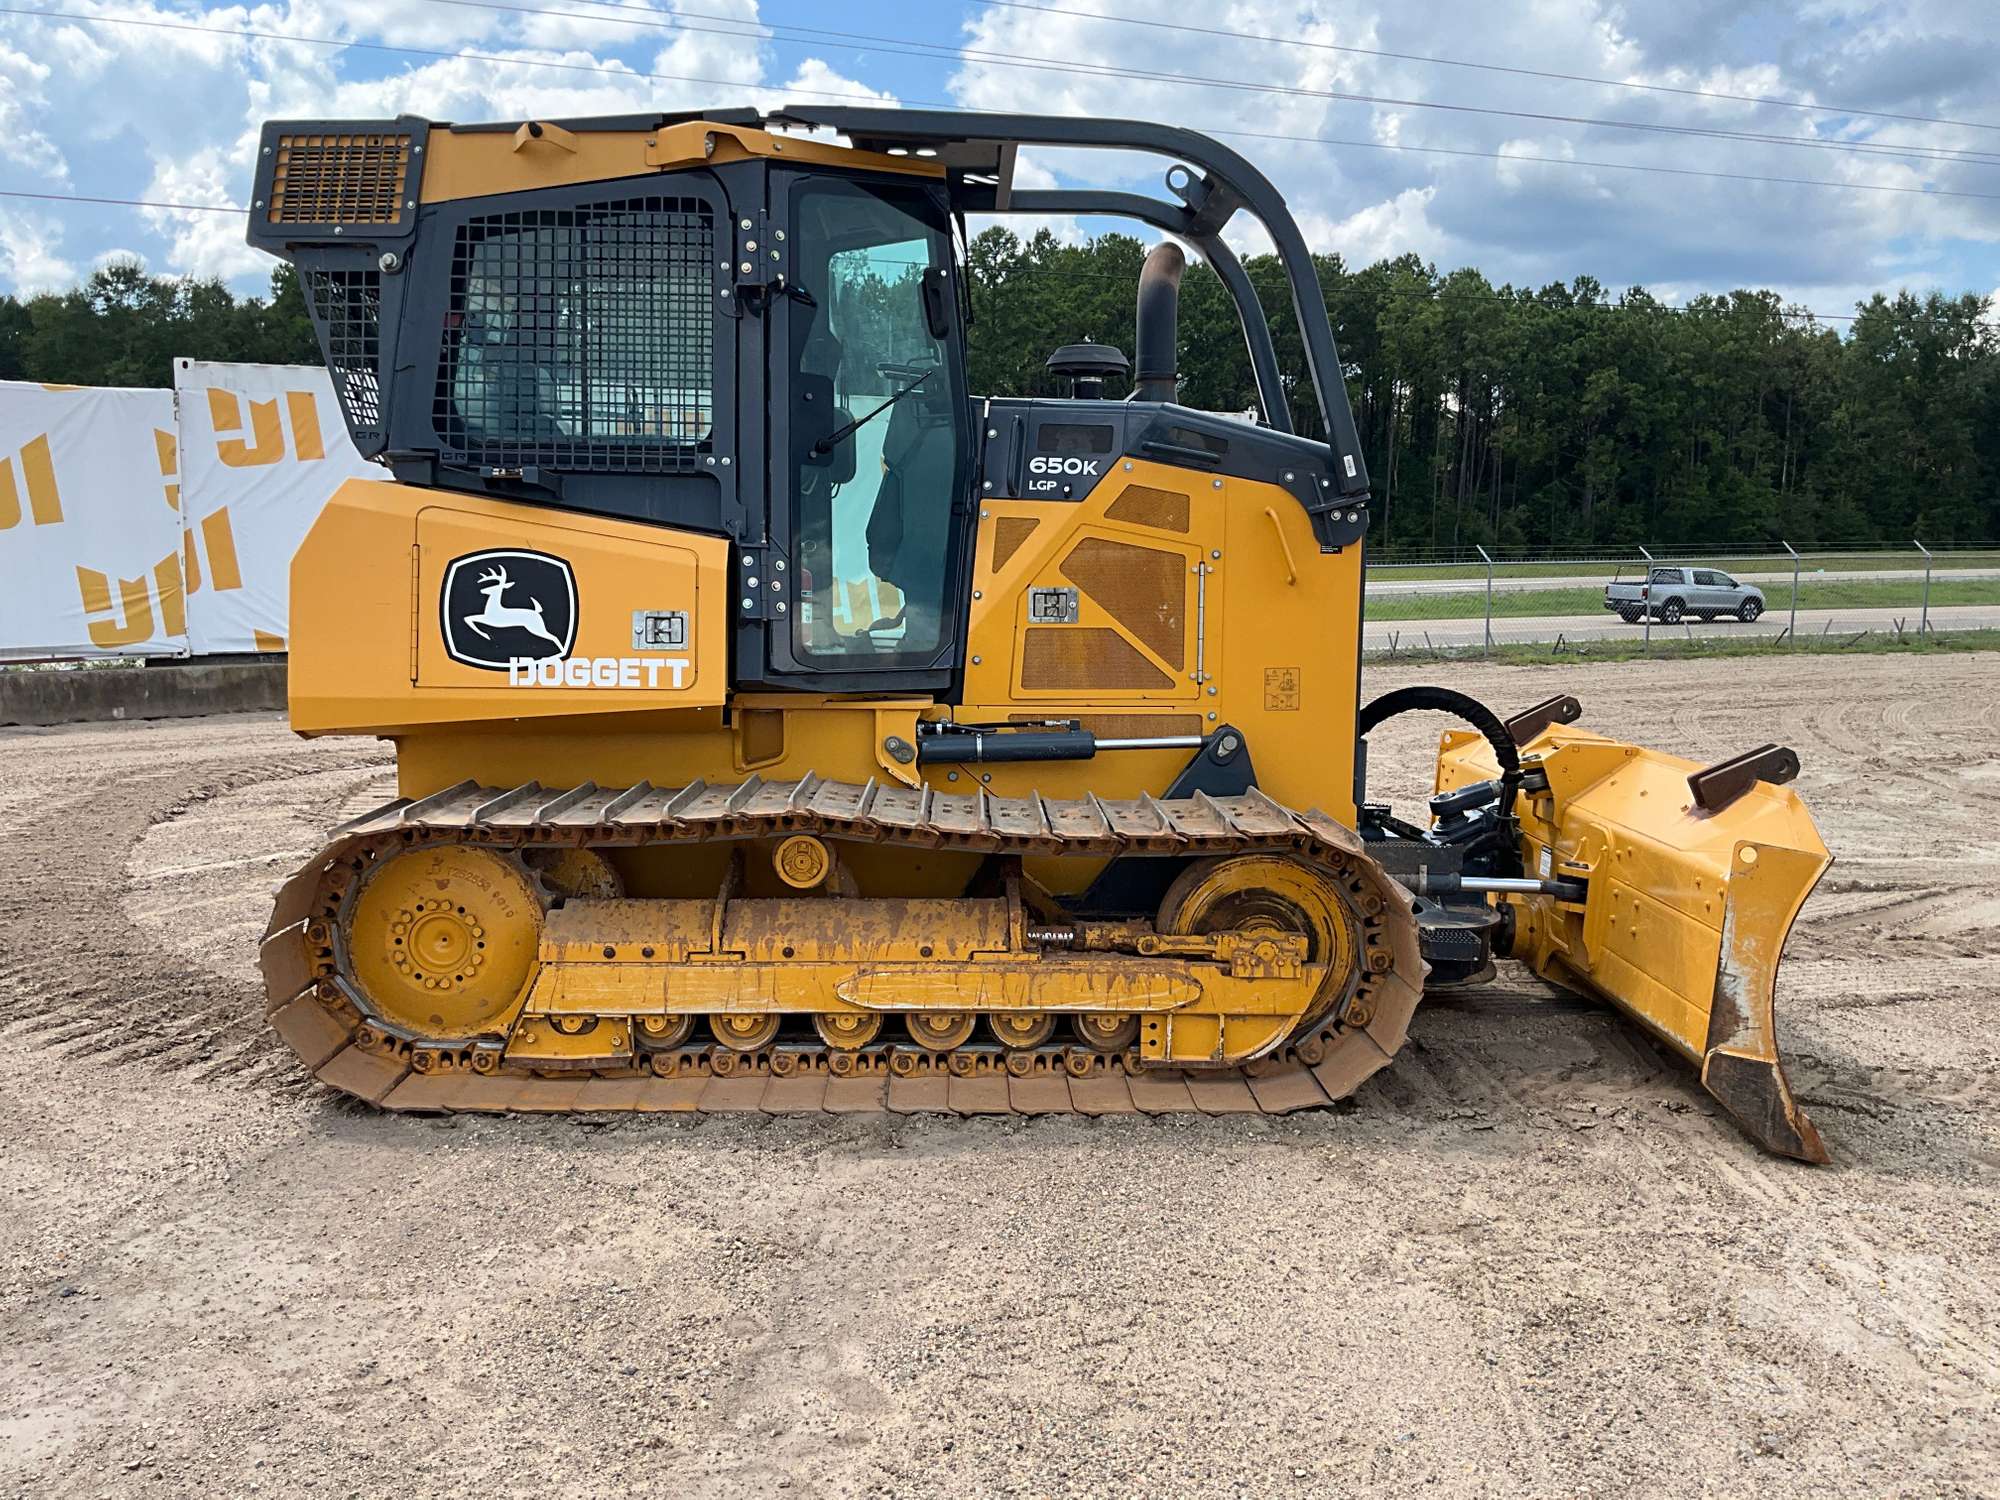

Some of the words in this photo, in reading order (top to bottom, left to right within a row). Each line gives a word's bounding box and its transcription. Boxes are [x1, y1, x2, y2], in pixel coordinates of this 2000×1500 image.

[1029, 456, 1098, 476] 650K
[1028, 480, 1057, 491] LGP
[509, 656, 689, 688] DOGGETT
